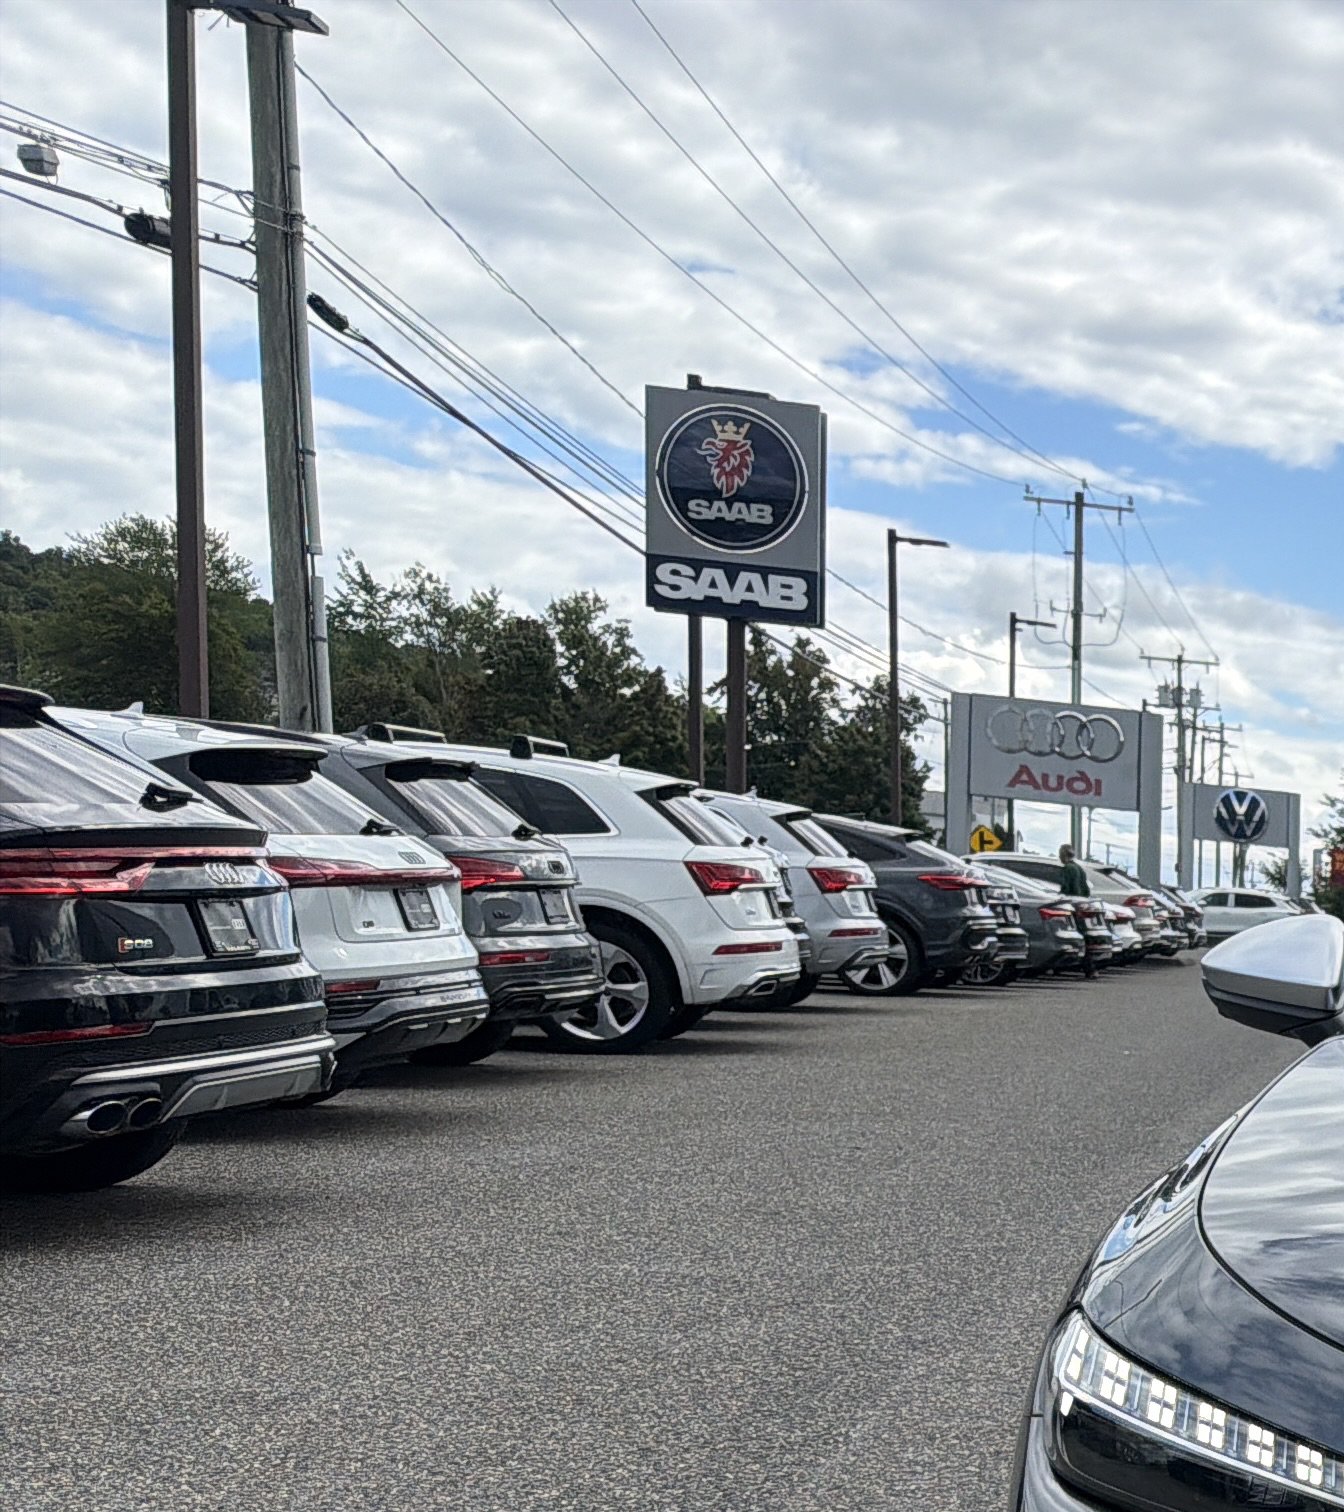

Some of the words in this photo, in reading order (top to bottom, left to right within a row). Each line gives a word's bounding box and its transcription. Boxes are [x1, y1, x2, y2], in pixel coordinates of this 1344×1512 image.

[686, 498, 774, 525] SAAB
[654, 562, 809, 611] SAAB
[1006, 764, 1103, 797] Audi
